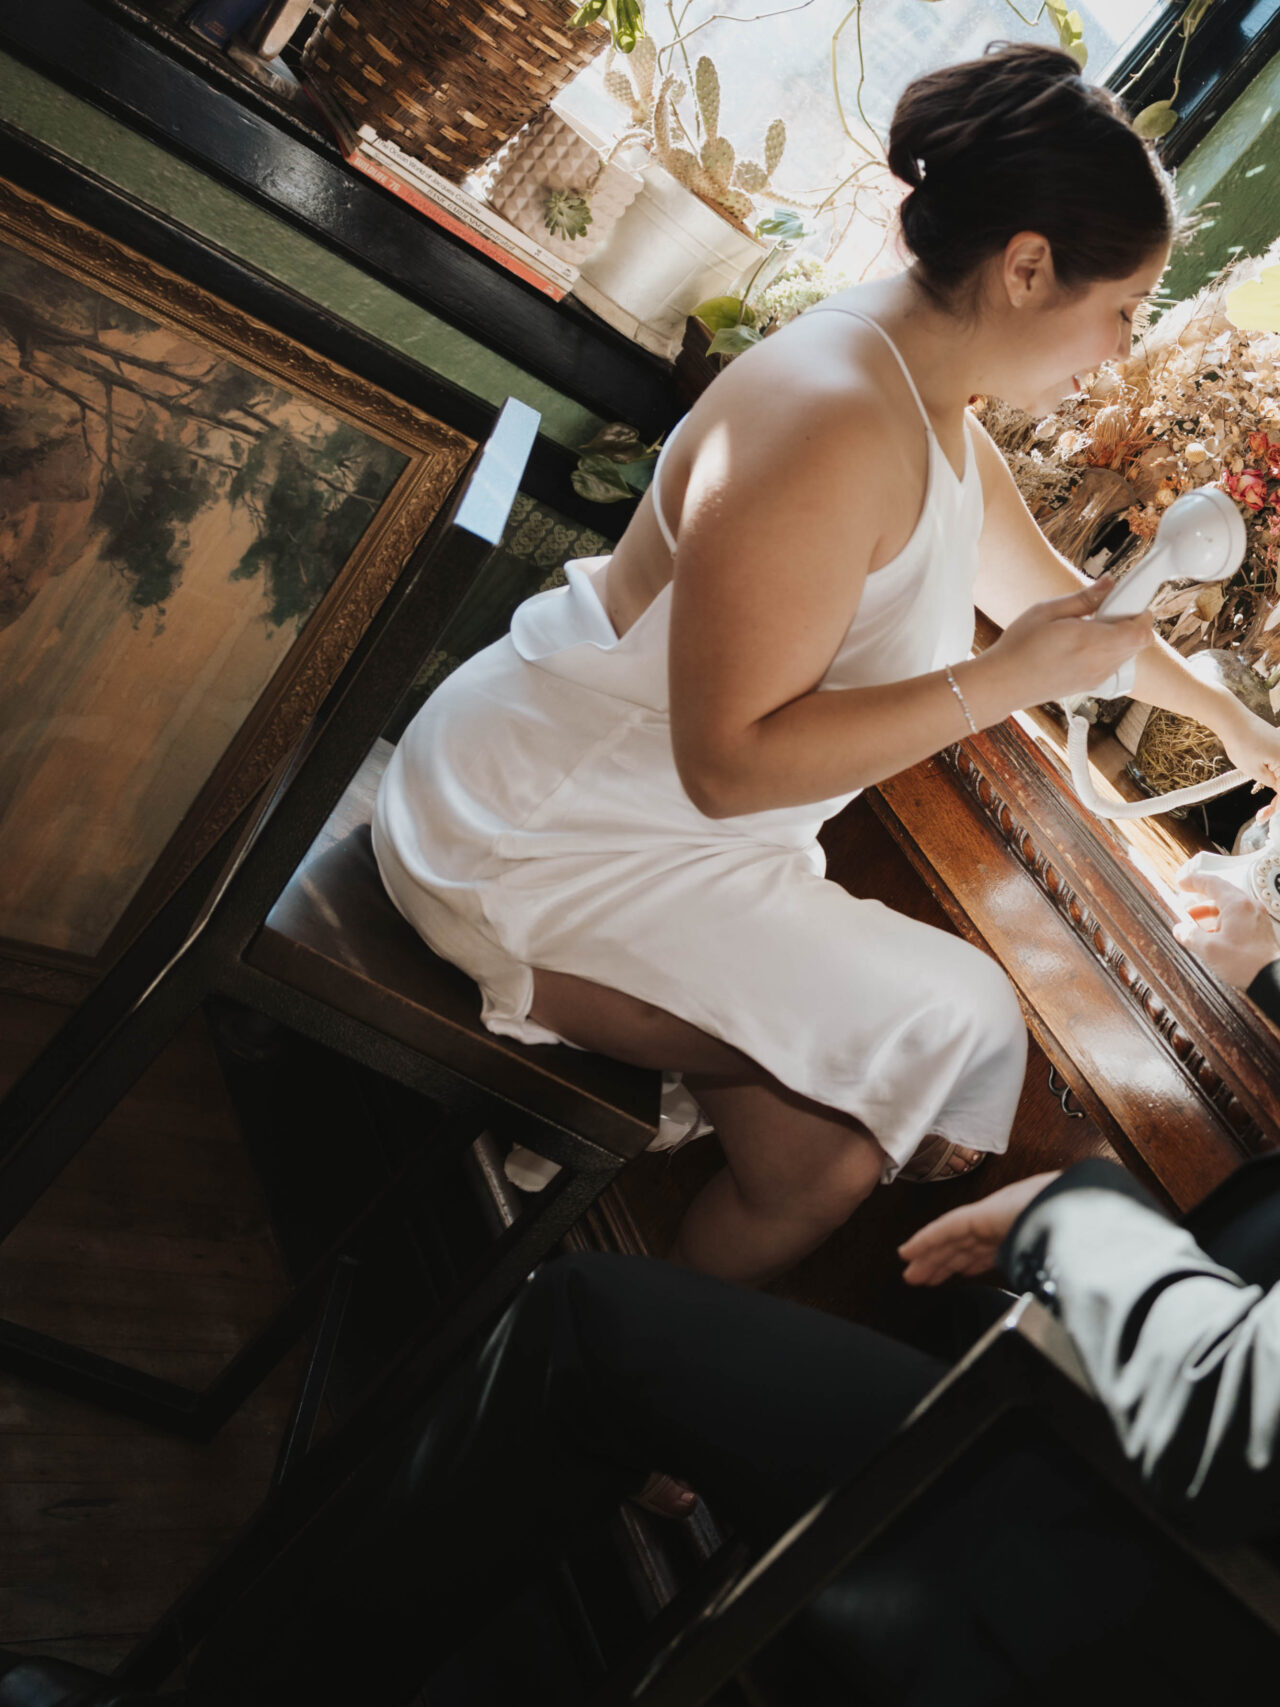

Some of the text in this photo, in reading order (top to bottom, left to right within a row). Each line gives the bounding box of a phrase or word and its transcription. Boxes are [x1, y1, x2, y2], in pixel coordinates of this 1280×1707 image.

[354, 157, 387, 181] WILDLIFE
[387, 146, 409, 164] Ocean
[407, 160, 426, 176] World
[428, 175, 456, 197] Jacques
[453, 191, 483, 215] Cousteau
[444, 200, 484, 231] GARDENING
